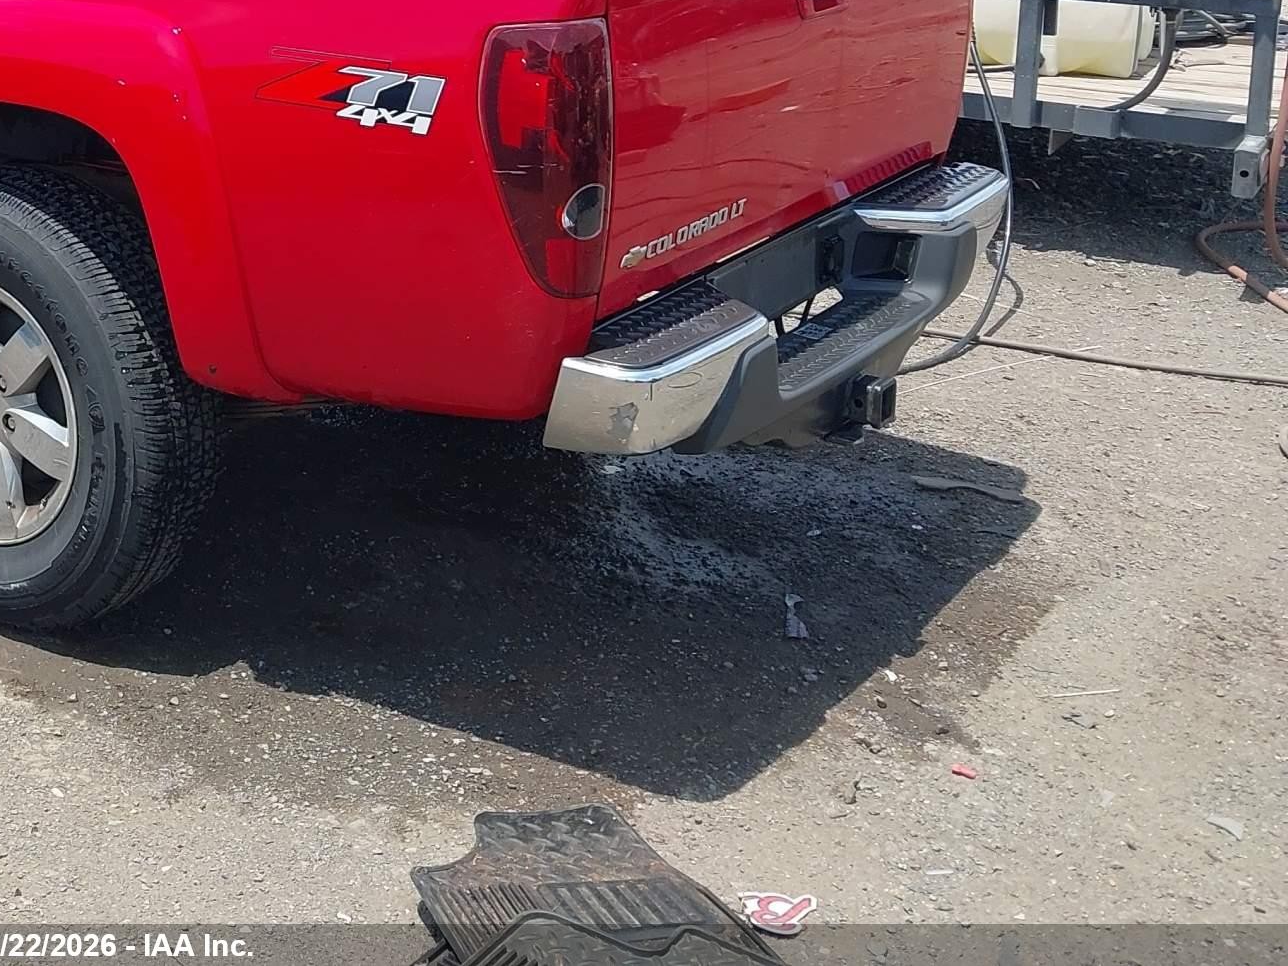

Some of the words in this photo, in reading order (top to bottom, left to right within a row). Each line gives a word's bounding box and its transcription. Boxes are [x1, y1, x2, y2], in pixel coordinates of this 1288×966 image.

[255, 45, 448, 116] Z71
[645, 206, 729, 259] COLORADO
[730, 198, 748, 220] LT
